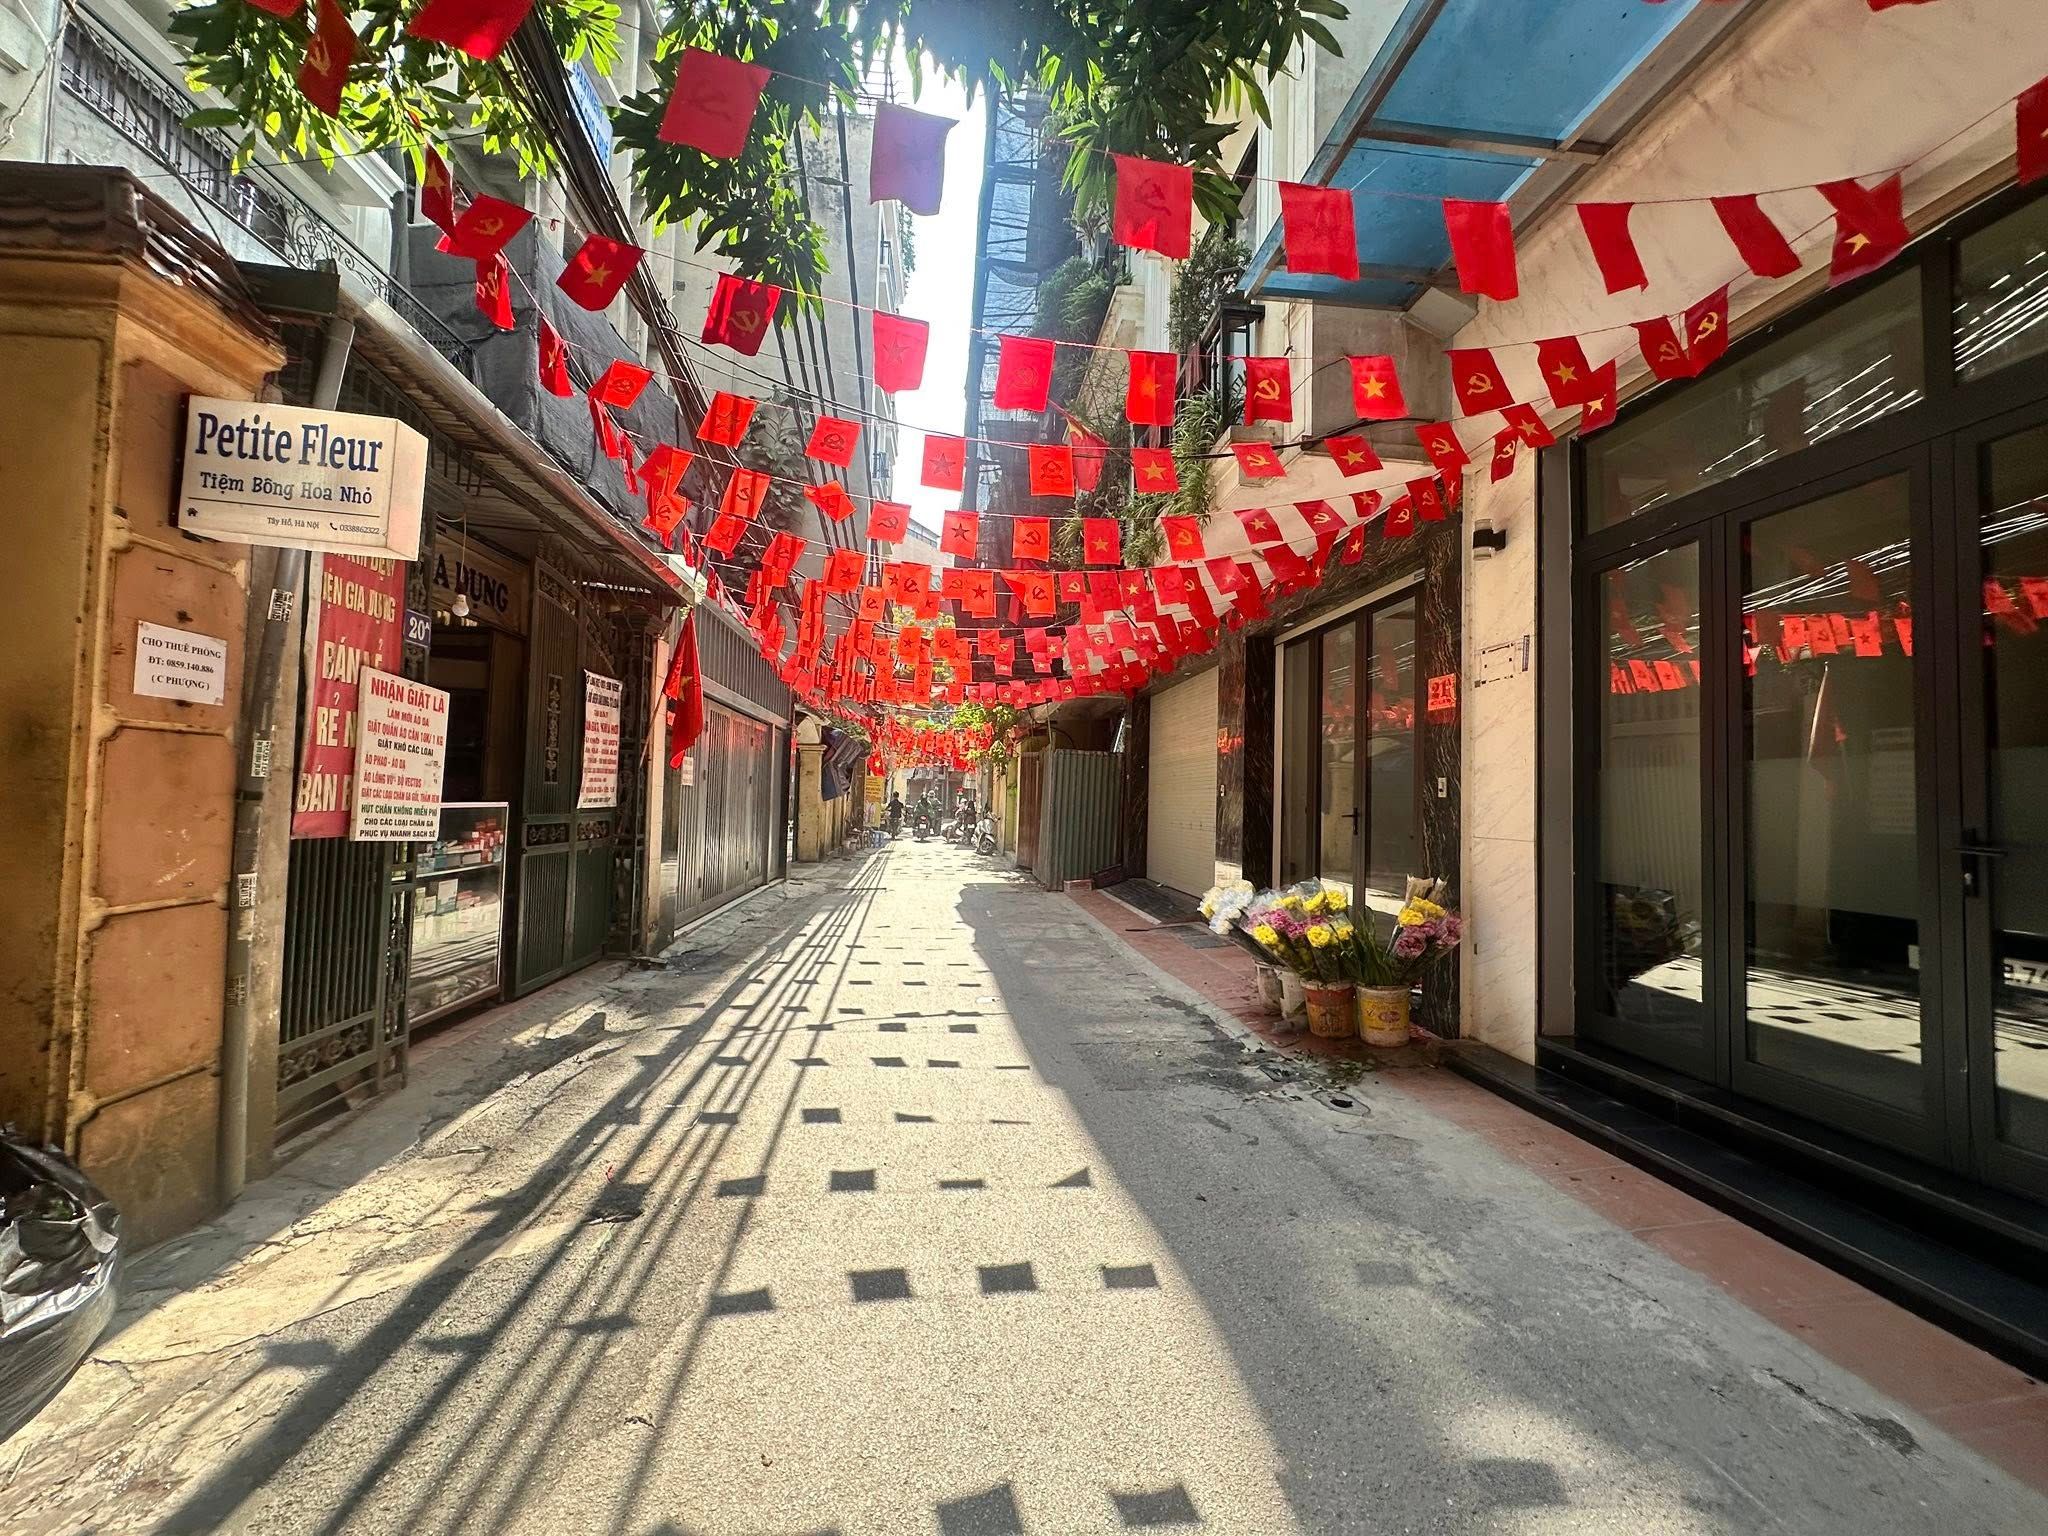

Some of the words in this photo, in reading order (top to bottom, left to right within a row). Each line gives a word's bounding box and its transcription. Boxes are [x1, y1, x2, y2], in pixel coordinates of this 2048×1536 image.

[195, 413, 292, 463] Petite
[298, 423, 383, 472] Fleur
[200, 472, 244, 494] Tiệm
[252, 476, 294, 500] Bông
[300, 482, 332, 501] Hoa
[340, 486, 372, 504] Nhỏ
[267, 517, 279, 526] Tây
[295, 519, 305, 528] Hà
[306, 520, 320, 529] Nội
[340, 524, 380, 534] 0338862322
[345, 581, 365, 614] GIA
[367, 588, 396, 624] DỤNG
[142, 636, 162, 647] CHO
[165, 641, 189, 653] THUÊ
[191, 646, 221, 659] PHÒNG
[148, 656, 164, 666] ĐT:
[322, 636, 360, 685] BÁN
[166, 676, 205, 689] PHƯỢNG
[371, 677, 404, 704] NHẬN
[407, 688, 431, 711] GIẶT
[433, 694, 445, 713] LÀ
[316, 691, 340, 747] RẺ
[367, 719, 381, 735] GIẶT
[377, 738, 392, 750] GIẶT
[393, 740, 406, 751] KHÔ
[408, 743, 420, 754] CÁC
[365, 752, 372, 765] ÁO
[364, 769, 371, 782] ÁO
[297, 764, 338, 813] BÁN
[364, 817, 378, 826] CHO
[380, 816, 393, 826] CÁC
[394, 818, 408, 827] LOẠI
[360, 829, 378, 838] PHỤC
[380, 830, 388, 838] VỤ
[390, 830, 411, 838] NHANH
